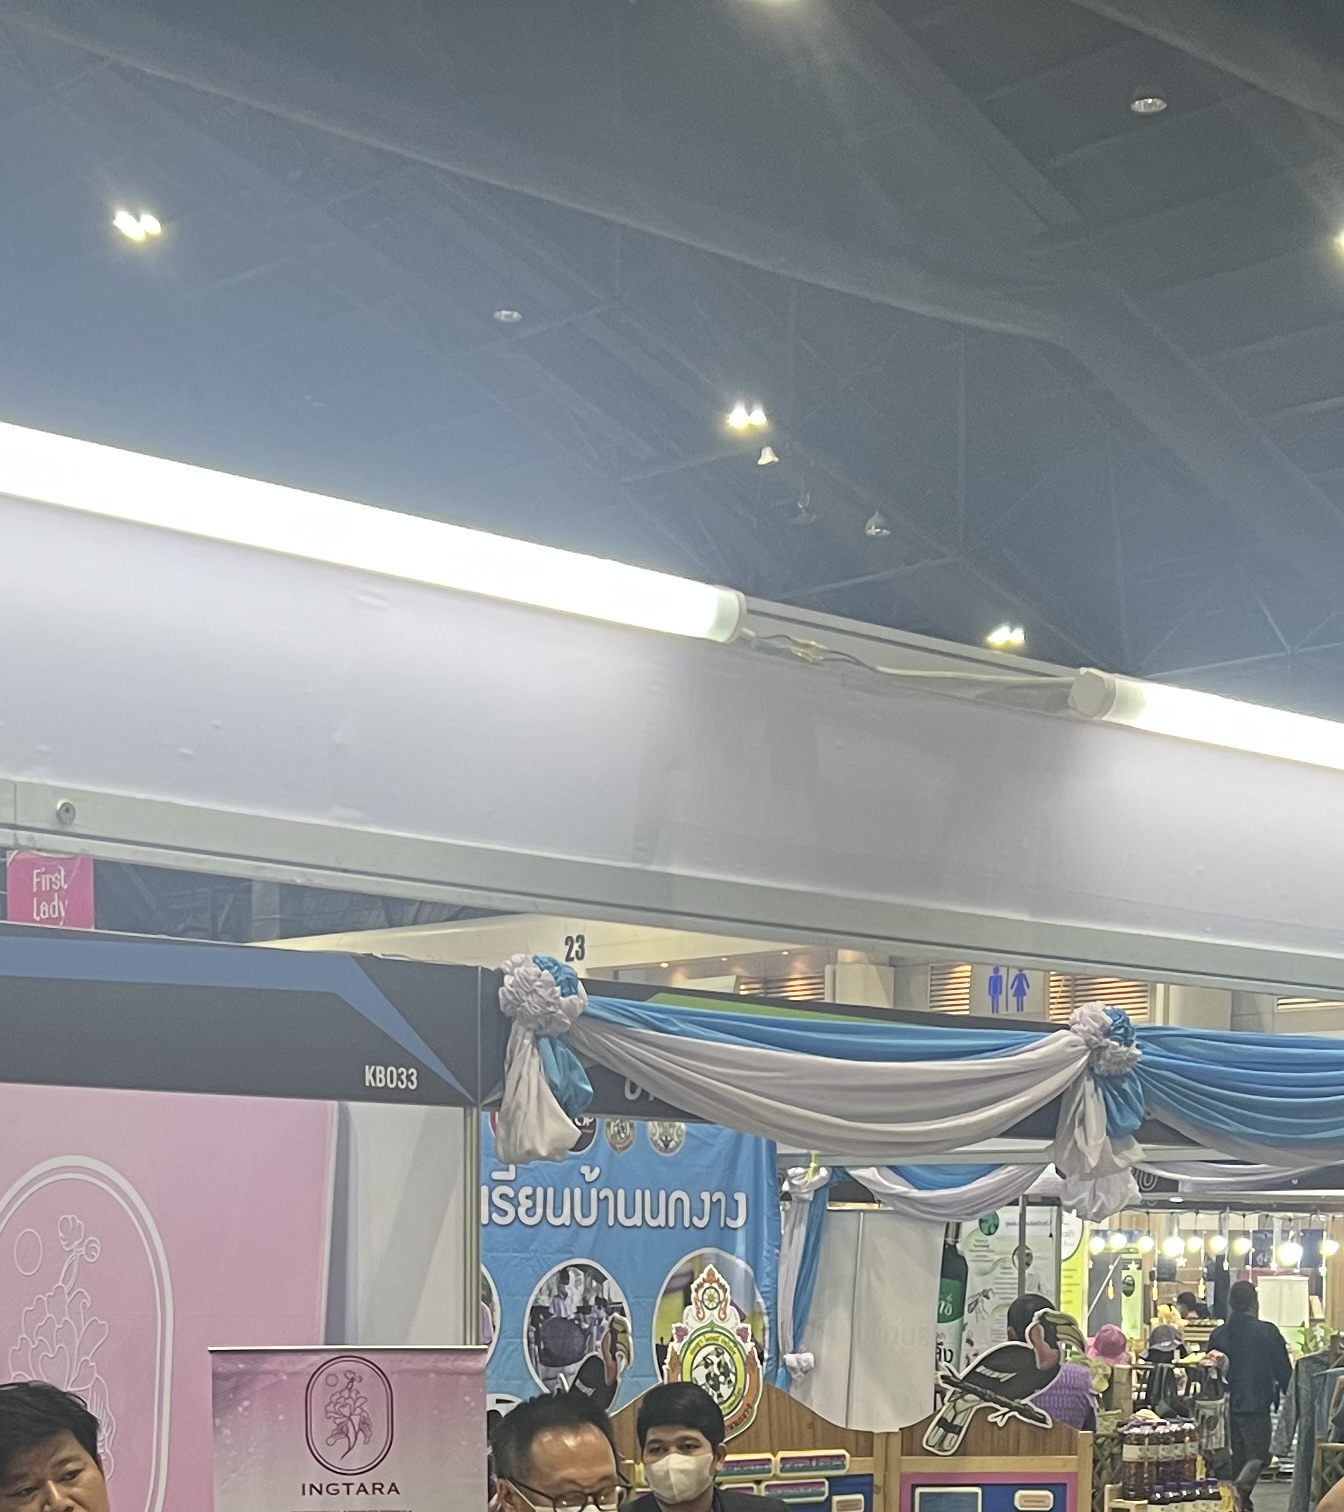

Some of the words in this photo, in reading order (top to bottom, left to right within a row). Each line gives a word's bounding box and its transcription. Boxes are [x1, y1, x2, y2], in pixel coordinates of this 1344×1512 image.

[32, 867, 68, 894] First
[32, 896, 69, 926] Lady
[564, 934, 586, 962] 23
[301, 1482, 401, 1496] INGTARA
